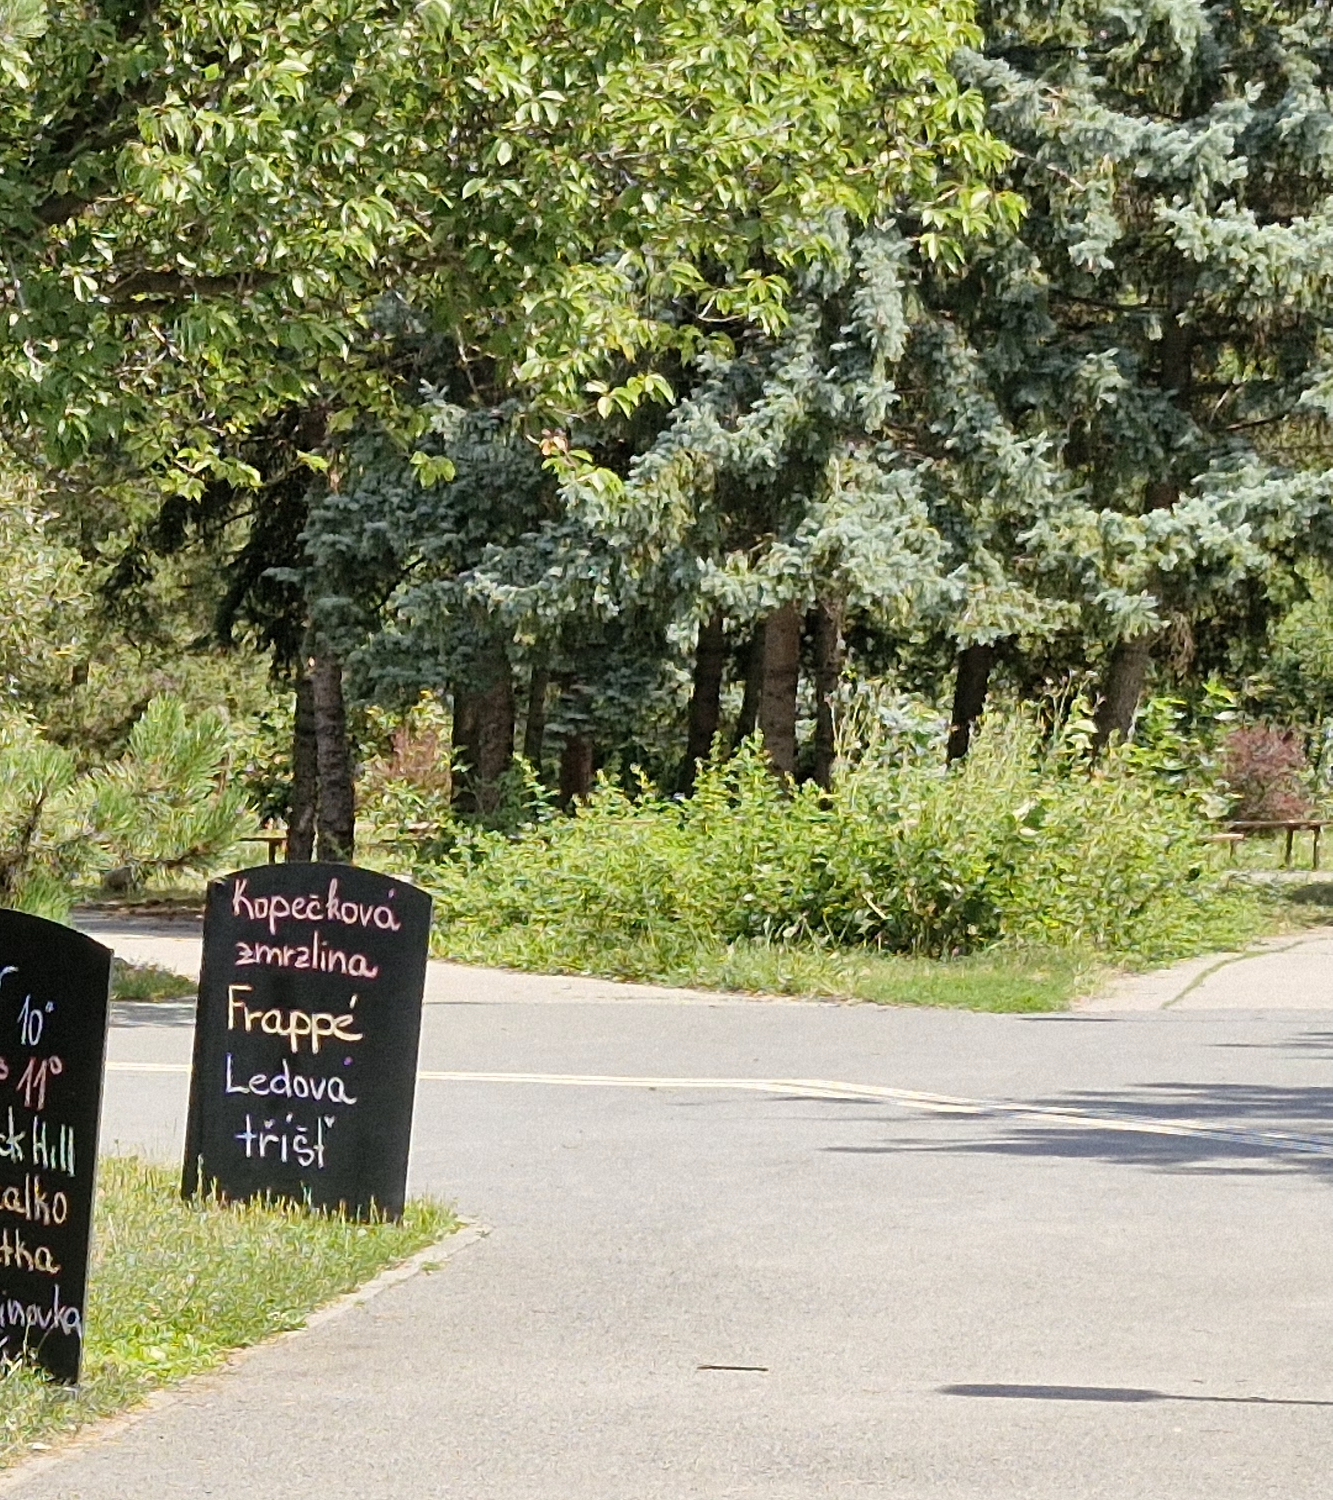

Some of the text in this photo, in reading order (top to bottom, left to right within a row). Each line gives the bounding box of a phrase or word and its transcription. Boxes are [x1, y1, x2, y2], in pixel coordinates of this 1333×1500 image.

[232, 877, 401, 935] Kopečková
[235, 931, 379, 979] zmrzlina
[227, 984, 364, 1054] Frappé
[225, 1051, 358, 1105] Ledová
[32, 1115, 76, 1178] Hill
